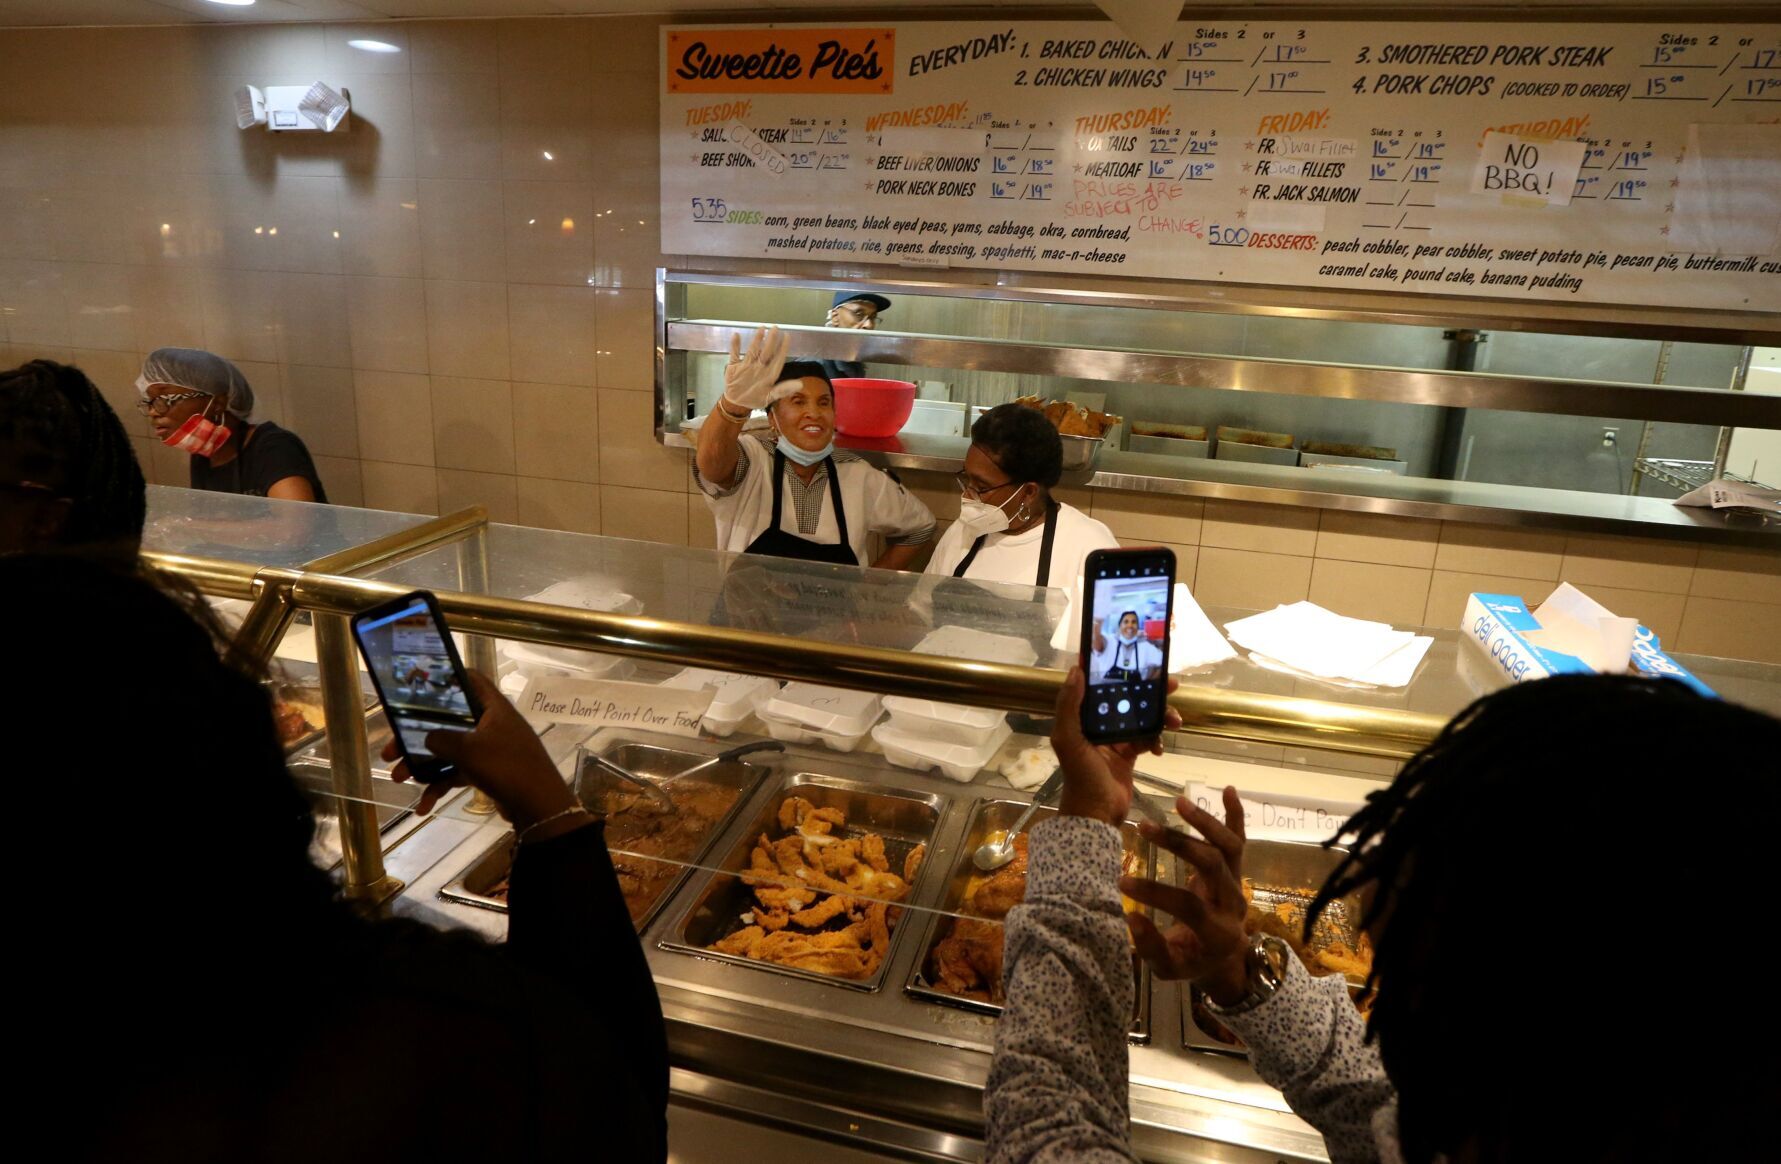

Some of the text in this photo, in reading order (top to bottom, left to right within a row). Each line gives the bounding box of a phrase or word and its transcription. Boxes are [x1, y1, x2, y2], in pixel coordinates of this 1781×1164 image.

[1195, 28, 1306, 40] Sides 2 or 3
[1659, 33, 1753, 47] Sides 2 or
[675, 39, 883, 80] Sweetie Pie's
[909, 28, 1017, 77] EVERYDAY:
[1020, 42, 1030, 59] 1.
[1040, 40, 1096, 59] BAKED
[1355, 44, 1613, 67] 3. SMOTHERED PORK STEAK
[1014, 67, 1168, 88] 2. CHICKEN WINGS
[1352, 74, 1631, 101] 4. PORK CHOPS (COOKED TO ORDER)
[685, 98, 753, 126] TUESDAY:
[789, 118, 807, 126] Sides
[1075, 104, 1172, 136] THURSDAY:
[1257, 108, 1331, 135] FRIDAY:
[1150, 127, 1170, 135] Sides
[1370, 128, 1392, 137] Sides
[1397, 129, 1404, 137] 2
[730, 125, 785, 174] CLOSED
[1108, 136, 1137, 152] TAILS
[1257, 138, 1275, 154] FR.
[701, 152, 725, 167] BEEF
[877, 155, 903, 170] BEEF
[1504, 143, 1539, 169] NO
[1084, 161, 1144, 178] MEATLOAF
[1301, 161, 1345, 178] FILLETS
[1484, 165, 1554, 195] BBQ!
[876, 179, 977, 197] PORK NECK BONES
[1073, 178, 1183, 200] PRICES ARE
[1252, 184, 1361, 204] FR. JACK SALMON
[691, 197, 727, 219] 5.35
[1064, 197, 1159, 218] SUBJECT TO
[726, 210, 1131, 242] SIDES: corn, green beans, black eyed peas, yams, cabbage, okra, cornbread,
[1209, 225, 1249, 244] 5.00
[767, 235, 809, 249] mashed
[809, 237, 857, 253] potatoes,
[861, 238, 882, 252] rice,
[928, 240, 977, 260] dressing,
[980, 243, 1036, 261] spaghetti,
[1041, 248, 1126, 263] mac-n-cheese
[1247, 232, 1319, 251] DESSERTS:
[1321, 237, 1360, 255] peach
[1362, 240, 1409, 258] cobbler,
[1412, 244, 1445, 260] pear
[1445, 244, 1493, 261] cobbler,
[1498, 248, 1538, 262] sweet
[1537, 250, 1583, 267] potato
[1583, 251, 1607, 268] pie,
[1610, 254, 1653, 270] pecan
[1653, 254, 1679, 272] pie,
[1684, 254, 1759, 273] buttermilk
[1319, 262, 1583, 293] caramel cake, pound cake, banana pudding
[1473, 615, 1499, 646] deli
[531, 691, 703, 730] Please Don't Point Over Food
[1262, 801, 1306, 830] Don't
